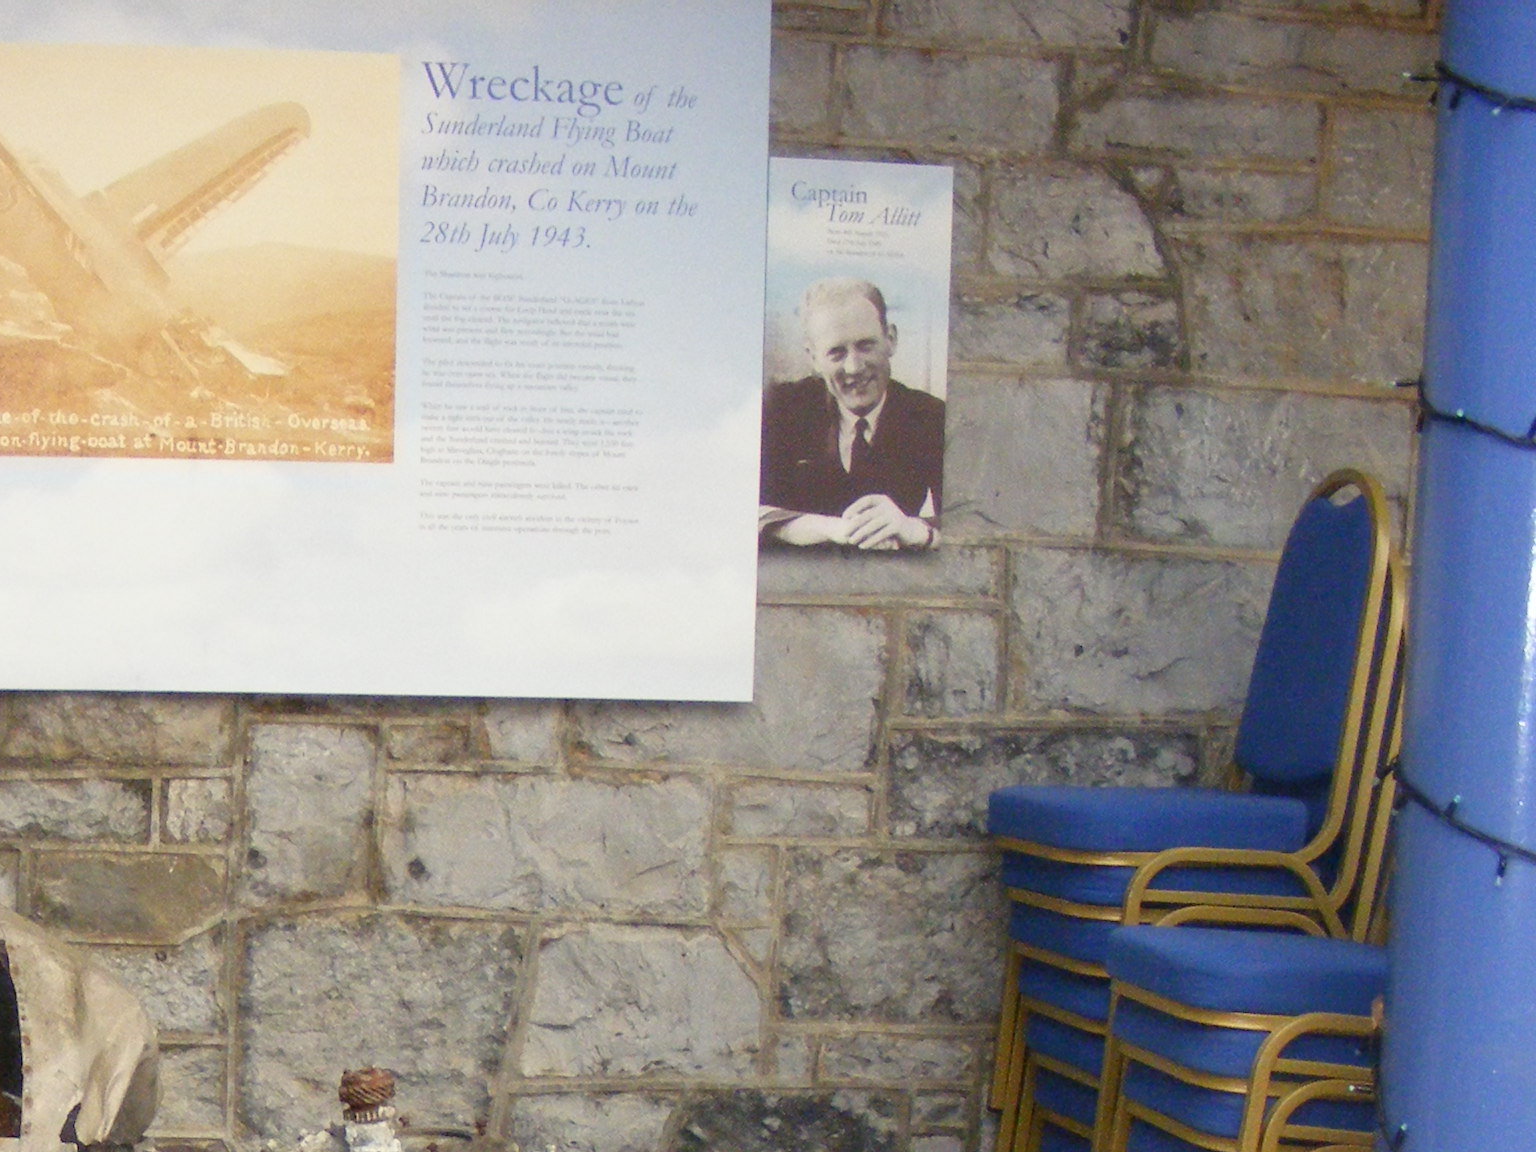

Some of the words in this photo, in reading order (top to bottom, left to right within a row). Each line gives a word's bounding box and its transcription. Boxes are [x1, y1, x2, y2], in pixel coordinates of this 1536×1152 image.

[421, 61, 624, 117] Wreckage
[633, 85, 658, 114] of
[667, 86, 698, 109] the
[421, 111, 544, 138] Sunderland
[551, 116, 617, 149] Flying
[625, 119, 675, 144] Boat
[421, 150, 480, 173] which
[487, 152, 564, 176] crashed
[571, 160, 596, 176] on
[603, 154, 678, 180] Mount
[421, 184, 517, 214] Brandon,
[527, 188, 558, 212] Co
[566, 189, 627, 222] Kerry
[635, 199, 659, 216] on
[668, 193, 699, 217] the
[791, 180, 868, 208] Captain
[826, 203, 865, 224] Tom
[869, 206, 922, 226] Allitt
[419, 220, 471, 245] 28th
[474, 222, 520, 253] July
[531, 224, 591, 249] 1943.
[133, 433, 152, 449] at
